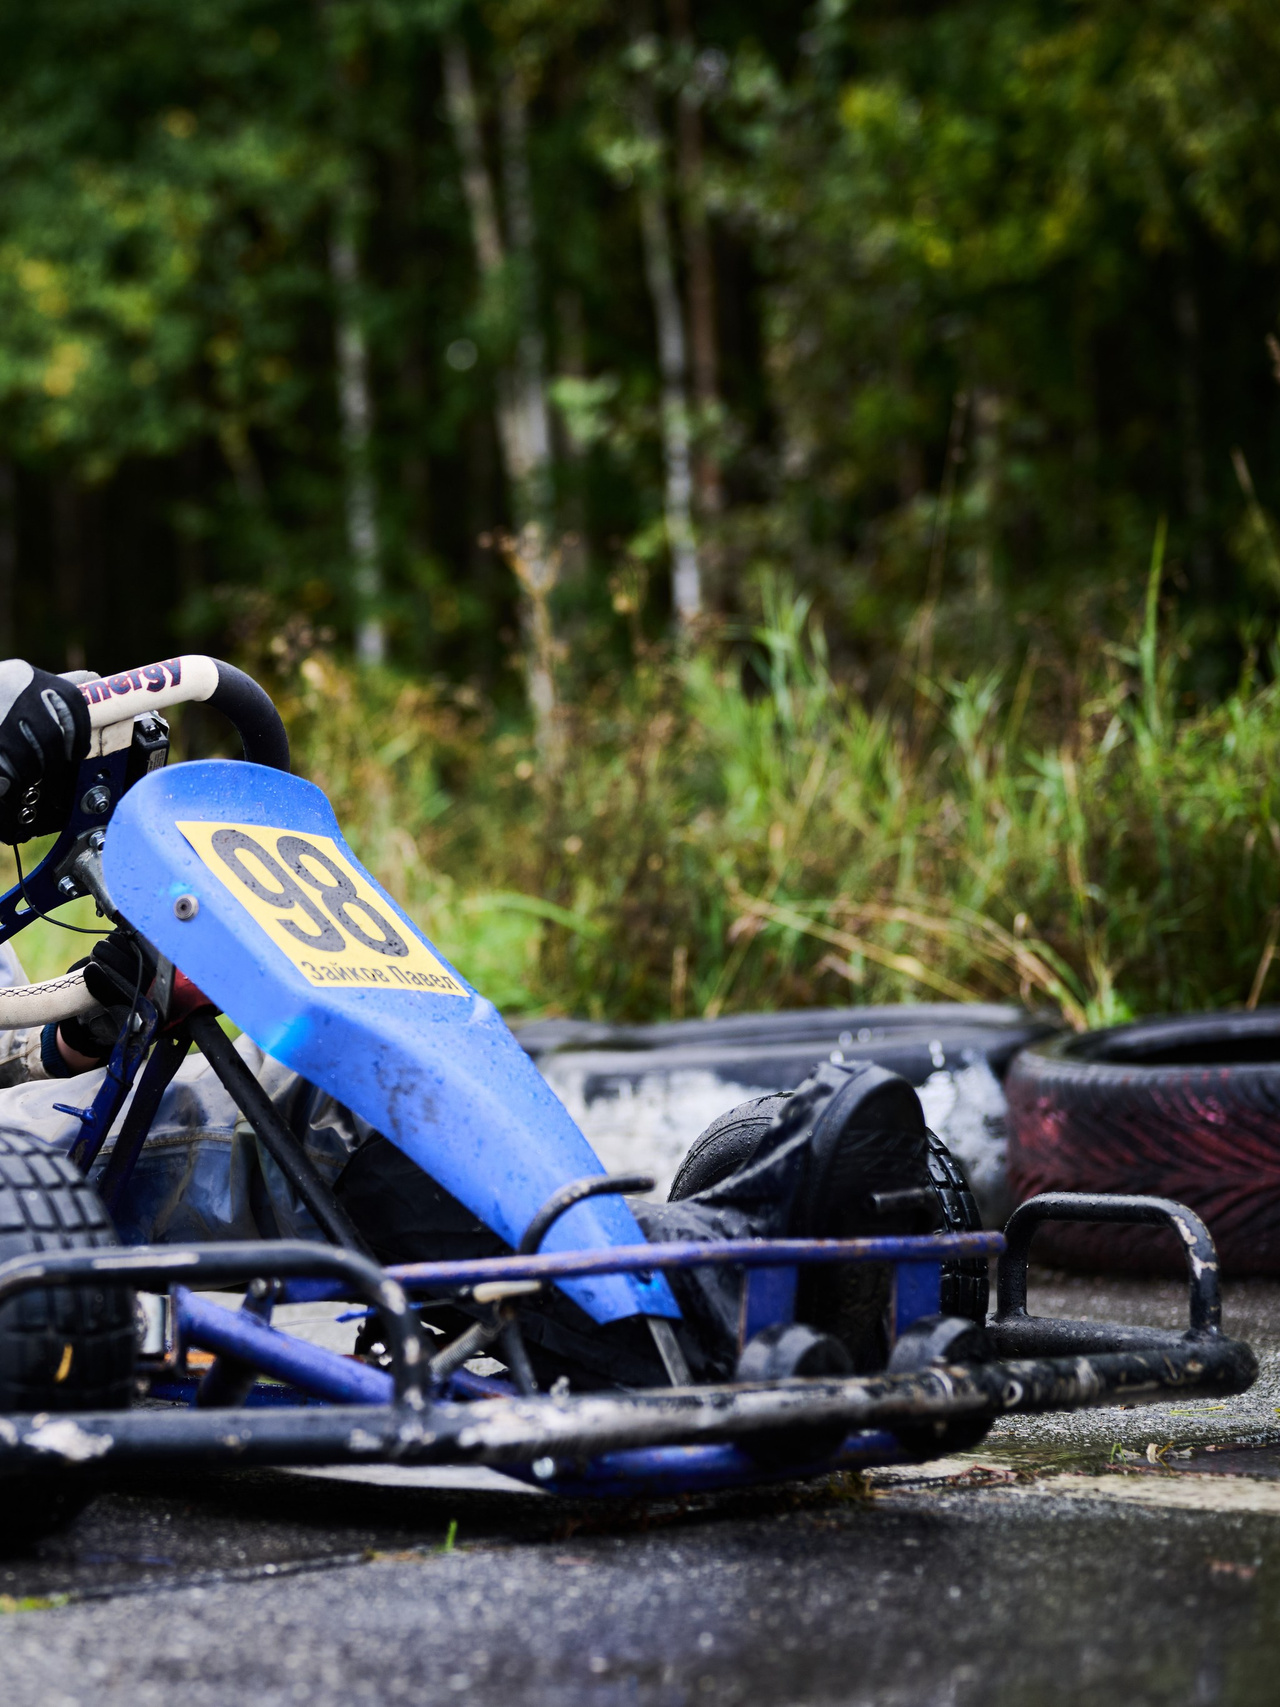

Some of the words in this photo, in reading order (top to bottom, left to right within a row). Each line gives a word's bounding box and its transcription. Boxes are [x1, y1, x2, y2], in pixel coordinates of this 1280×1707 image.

[211, 829, 410, 958] 98
[300, 961, 390, 982] Зайков
[386, 965, 461, 991] Павел
